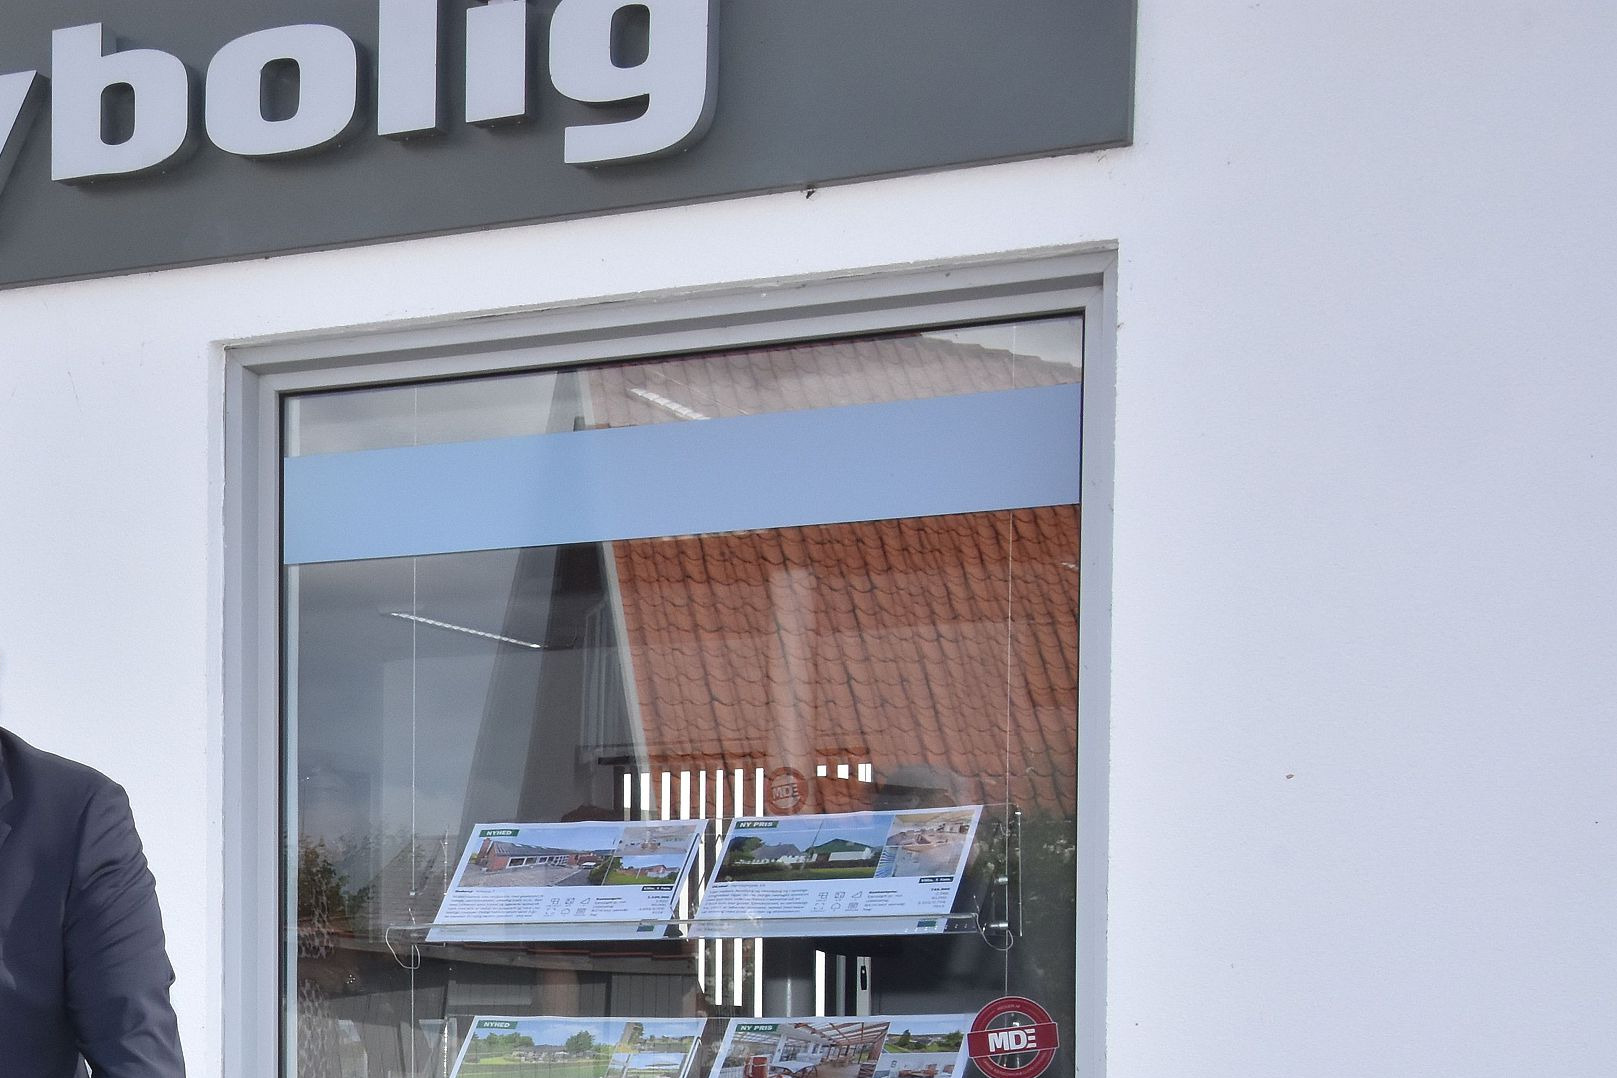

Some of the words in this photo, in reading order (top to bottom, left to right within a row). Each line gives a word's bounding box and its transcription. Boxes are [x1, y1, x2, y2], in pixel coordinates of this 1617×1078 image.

[486, 829, 513, 837] NYHED
[484, 1020, 511, 1028] NYHED
[752, 1024, 773, 1032] PRIS
[987, 1028, 1037, 1053] MDE
